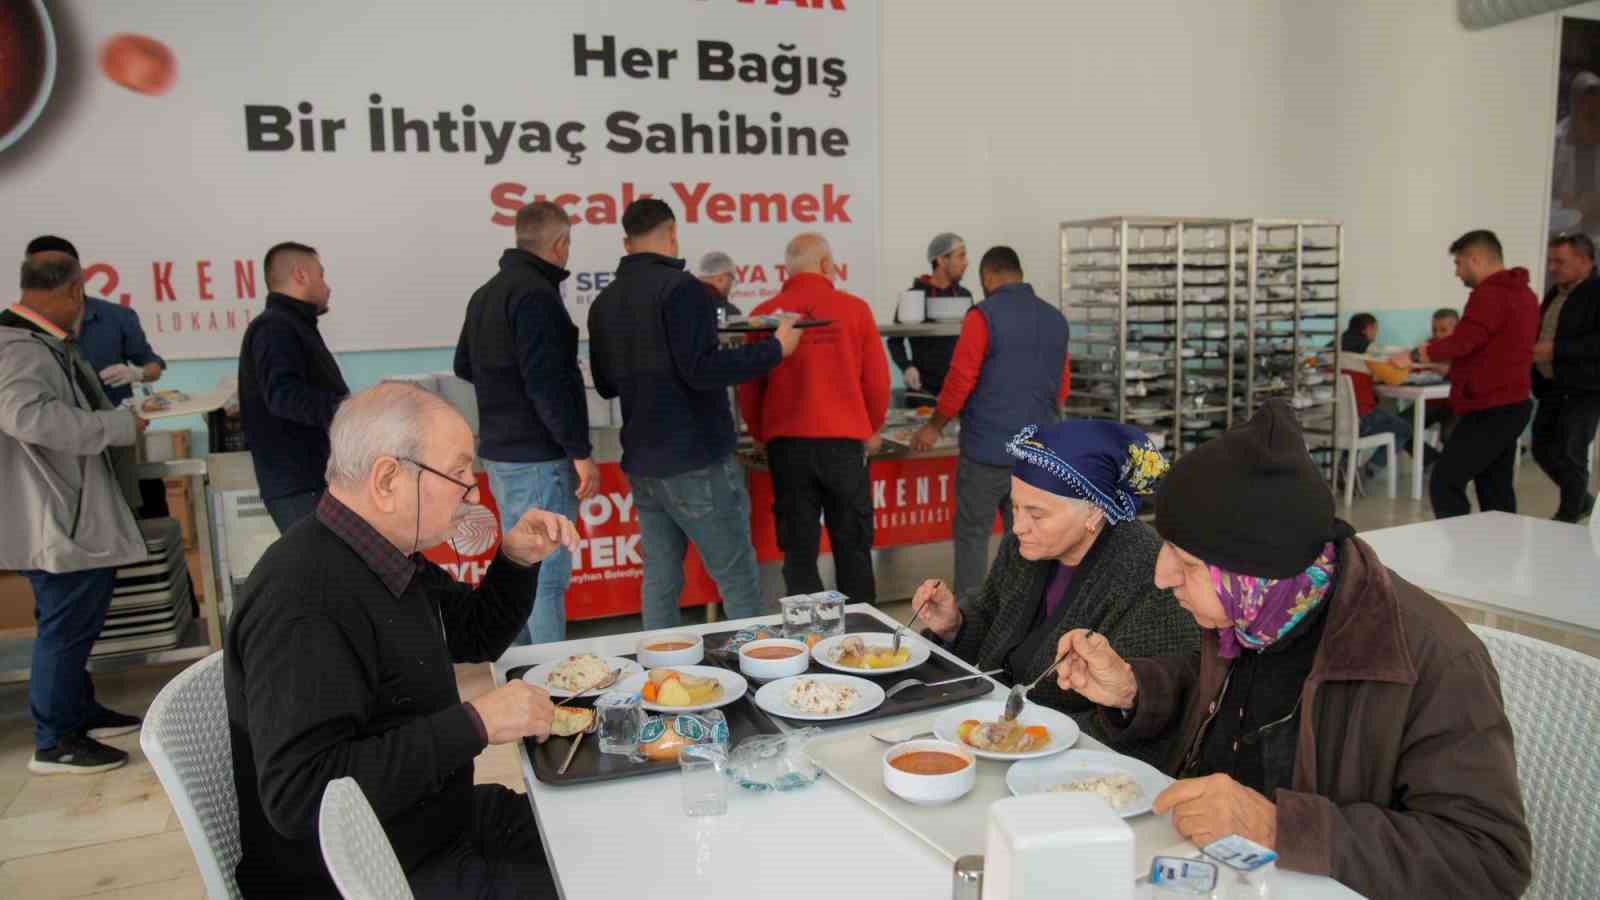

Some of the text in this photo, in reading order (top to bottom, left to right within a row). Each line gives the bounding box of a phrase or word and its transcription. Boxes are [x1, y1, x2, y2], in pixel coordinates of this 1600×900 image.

[572, 33, 848, 99] Her Bağış
[244, 92, 850, 166] Bir İhtiyaç Sahibine
[489, 180, 852, 228] Sca Yemek
[735, 263, 768, 284] YA
[579, 491, 640, 526] OY
[872, 474, 949, 510] KENT
